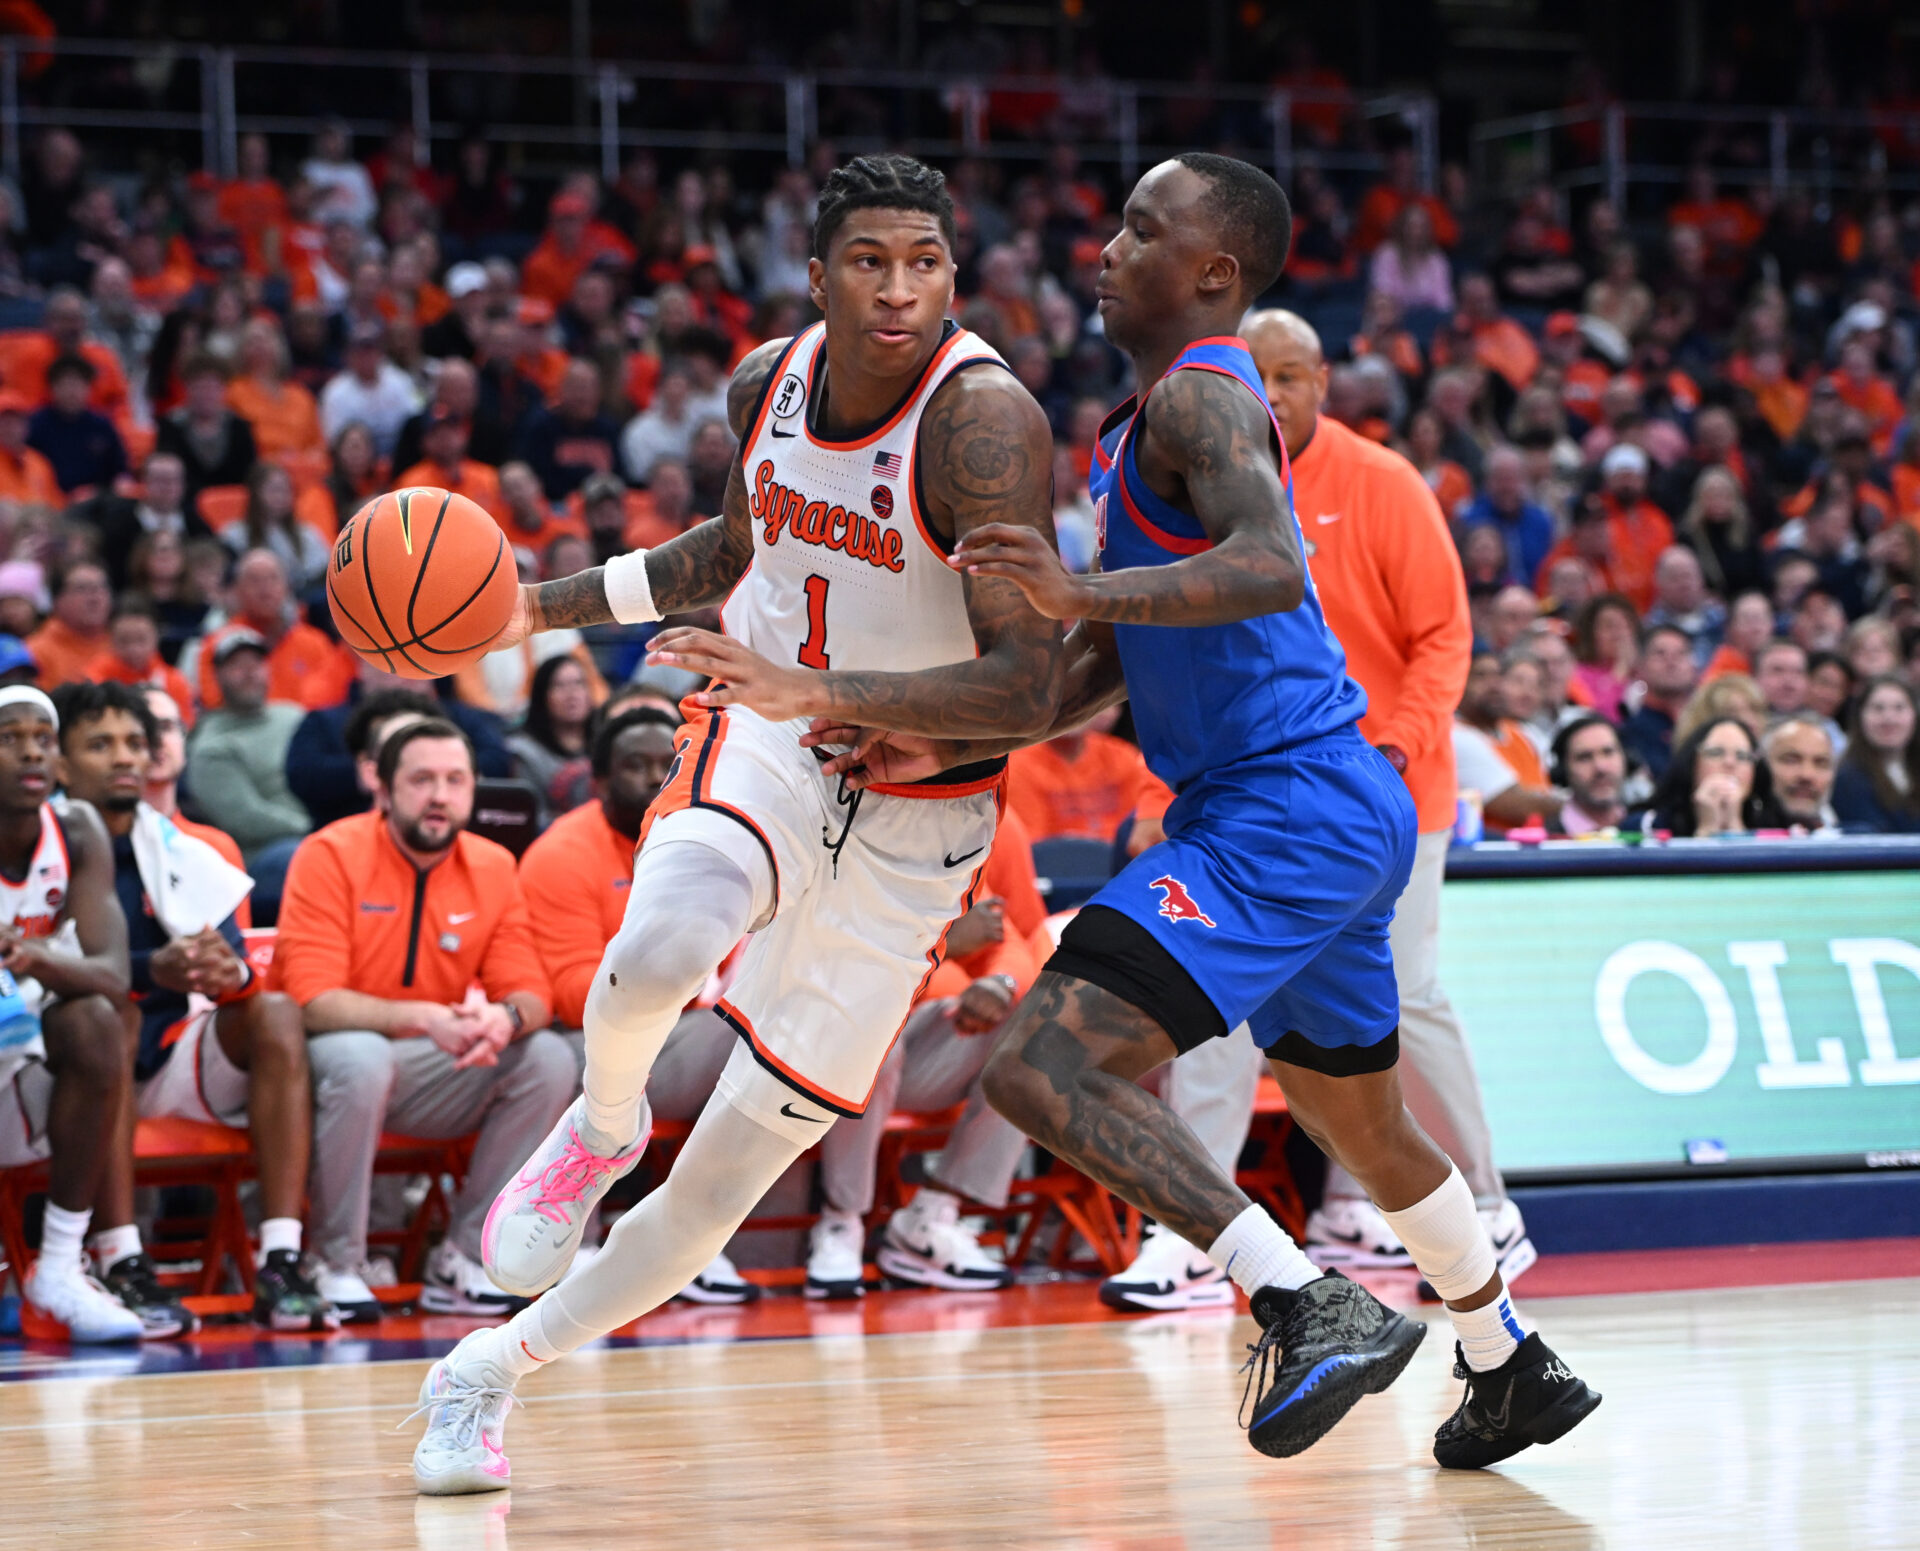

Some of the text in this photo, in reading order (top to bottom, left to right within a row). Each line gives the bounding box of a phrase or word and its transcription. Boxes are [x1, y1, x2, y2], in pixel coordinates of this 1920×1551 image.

[776, 392, 792, 414] 21
[784, 379, 798, 395] LM
[751, 460, 905, 573] Syracuse
[797, 573, 830, 670] 1
[1596, 939, 1920, 1095] OLD
